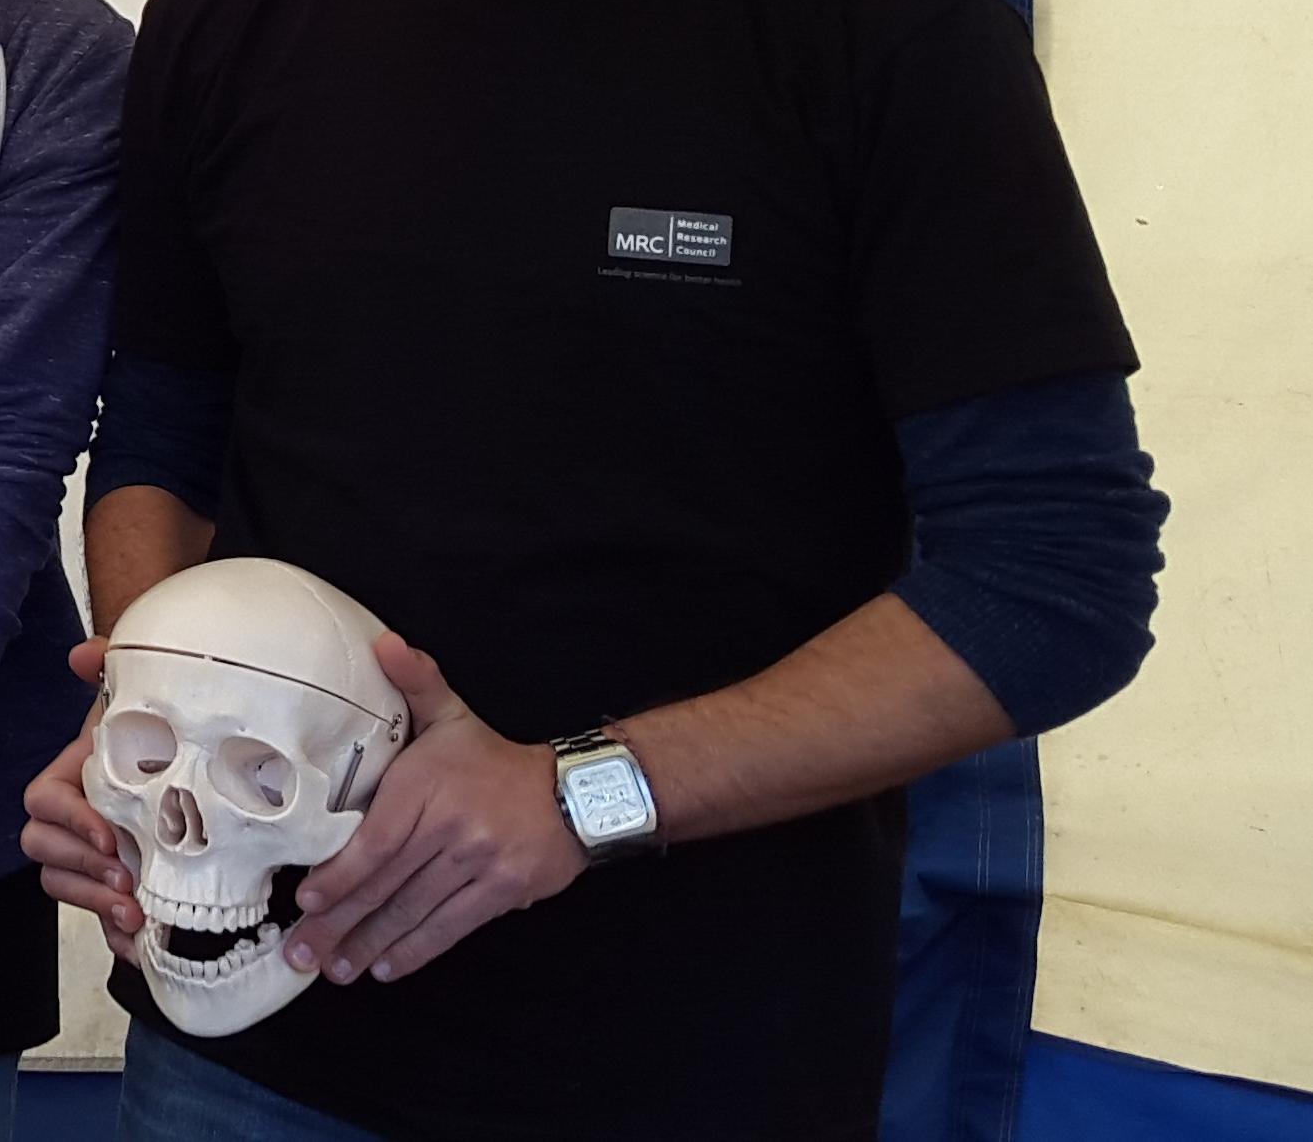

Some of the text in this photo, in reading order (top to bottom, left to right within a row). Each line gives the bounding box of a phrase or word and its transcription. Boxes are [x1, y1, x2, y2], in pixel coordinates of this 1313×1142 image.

[676, 219, 718, 232] Medical
[615, 233, 665, 254] MRC
[676, 232, 727, 246] Research
[675, 245, 717, 258] Council
